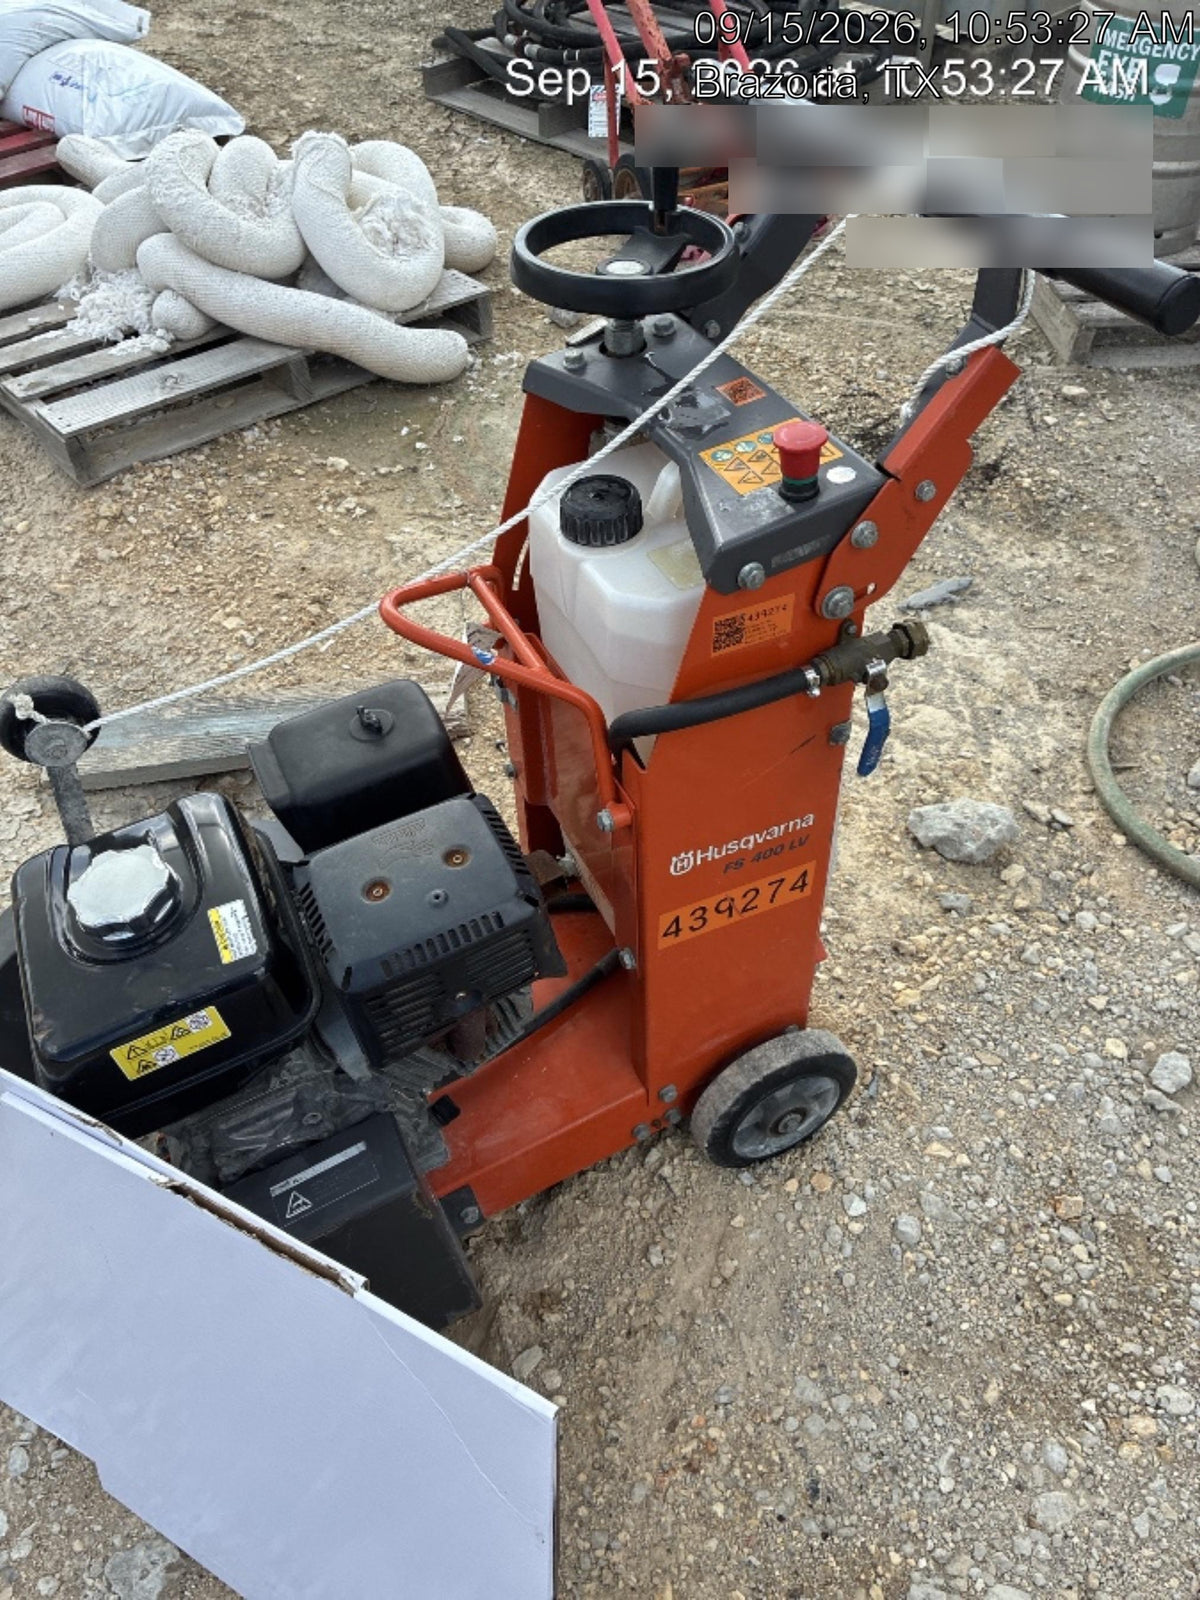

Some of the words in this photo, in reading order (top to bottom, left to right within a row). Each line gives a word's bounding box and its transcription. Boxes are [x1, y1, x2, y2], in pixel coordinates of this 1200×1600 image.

[696, 813, 815, 865] Husqvarna
[723, 858, 745, 875] FS
[751, 843, 785, 863] 400
[789, 834, 810, 850] LV
[662, 869, 809, 938] 439274
